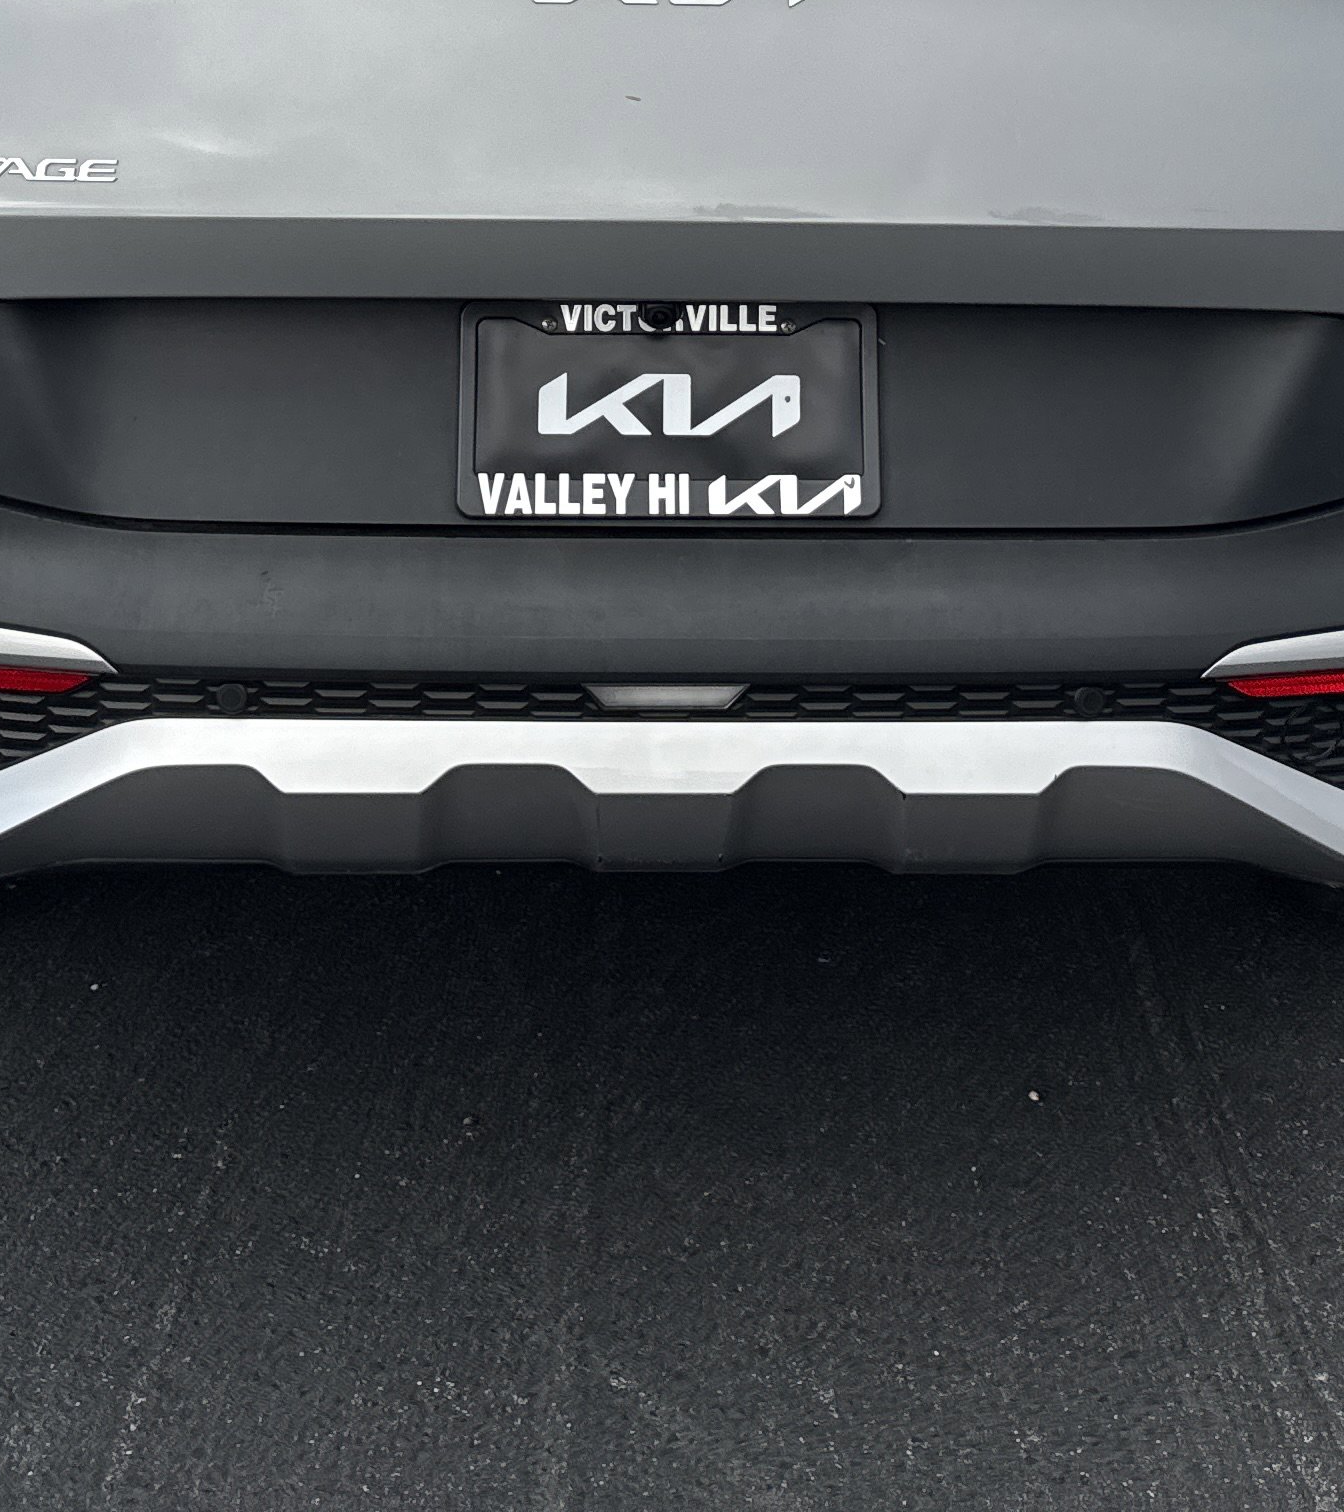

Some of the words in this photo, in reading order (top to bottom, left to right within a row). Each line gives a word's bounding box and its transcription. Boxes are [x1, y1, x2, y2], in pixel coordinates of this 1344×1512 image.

[559, 303, 778, 333] VICTVILLE
[537, 372, 802, 438] KIA
[477, 472, 636, 515] VALLEY
[648, 472, 691, 515] HI
[708, 473, 862, 515] KIA
